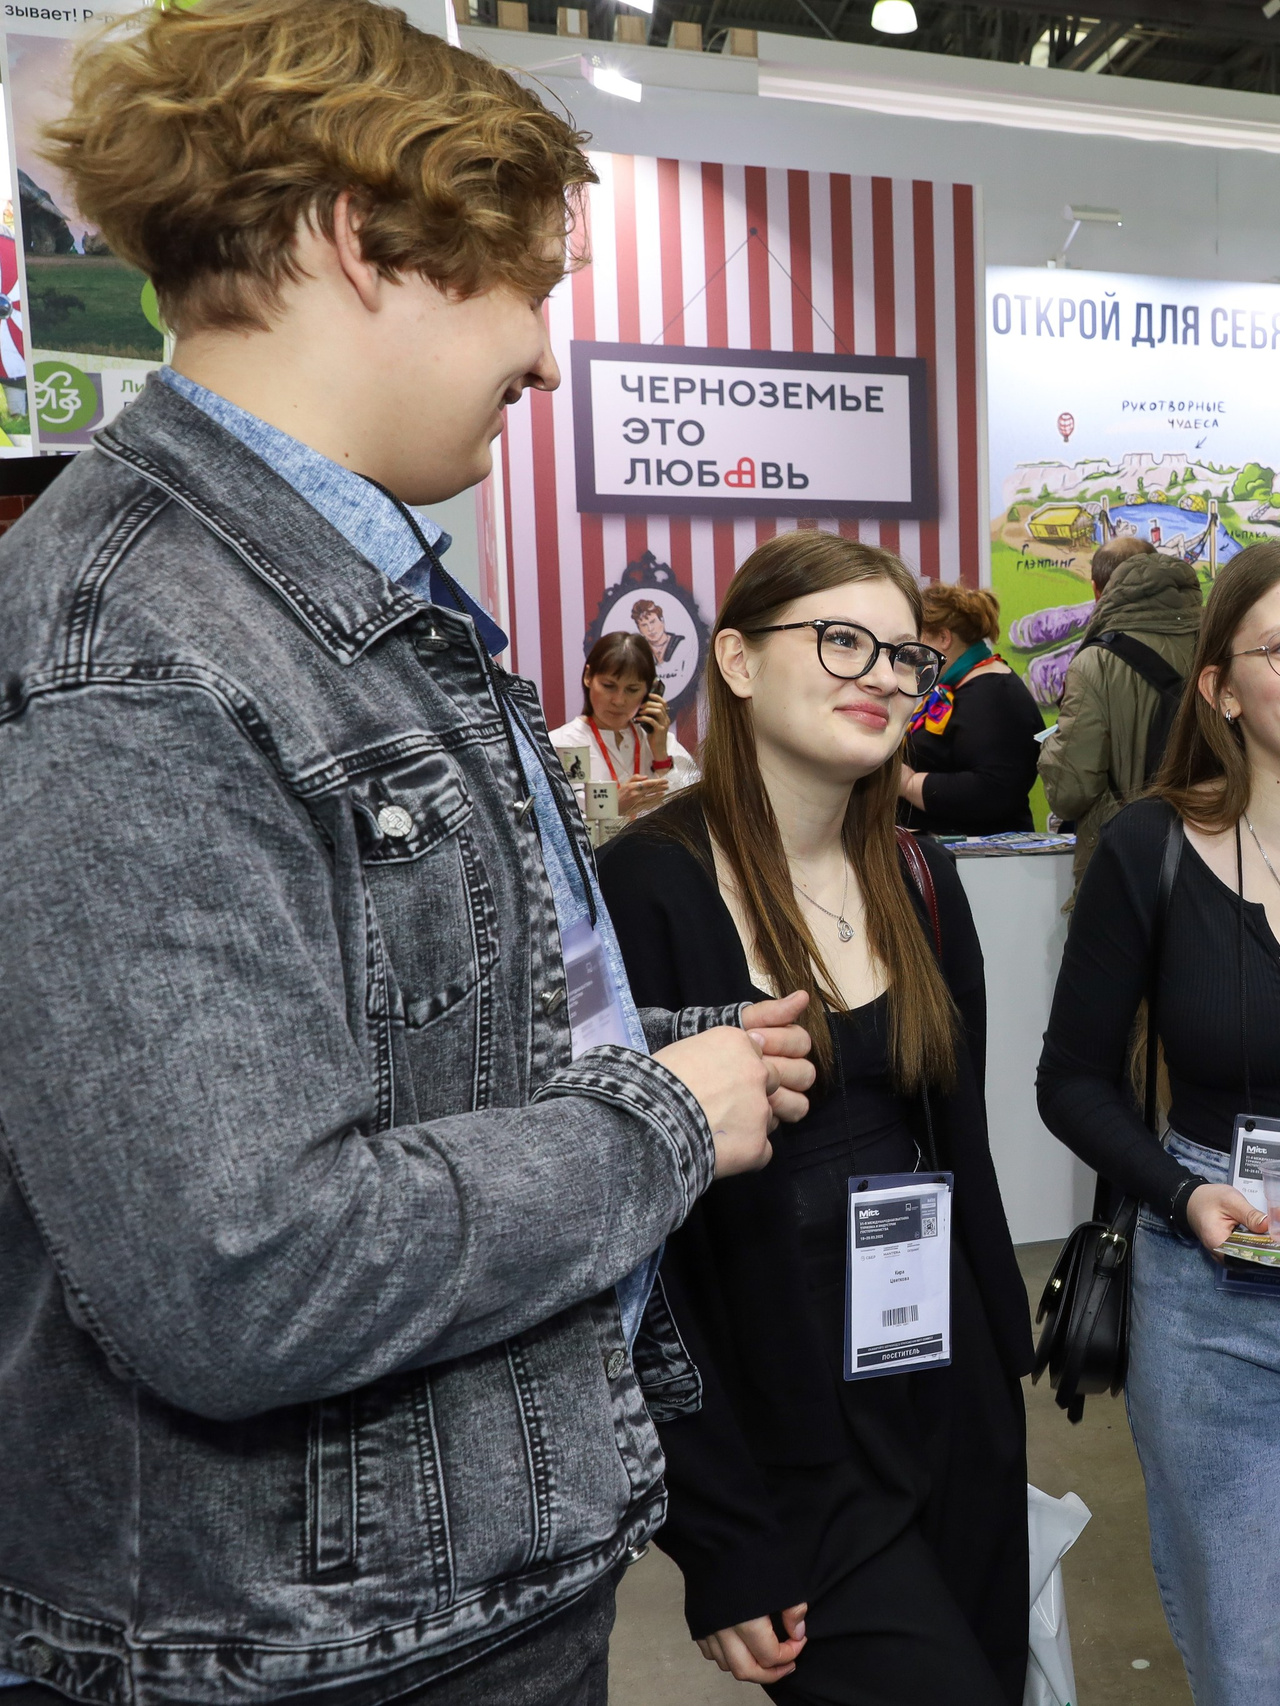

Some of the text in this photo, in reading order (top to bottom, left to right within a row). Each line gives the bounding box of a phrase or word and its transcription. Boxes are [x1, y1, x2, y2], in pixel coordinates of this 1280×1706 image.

[992, 291, 1120, 341] ОТКРОЙ
[1131, 302, 1200, 348] ДЛЯ
[621, 375, 884, 413] ЧЕРНОЗЕМЬЕ
[1121, 400, 1226, 413] РУКОТВОРНЫЕ
[1167, 418, 1219, 429] ЧУДЕСА
[622, 417, 705, 446] ЭТО
[1223, 530, 1268, 540] АЛЬПАКА
[1016, 557, 1076, 571] ГЛЭМПИНГ
[1246, 1145, 1268, 1154] Mitt
[859, 1208, 880, 1220] Mitt
[881, 1348, 921, 1361] ПОСЕТИТЕЛЬ
